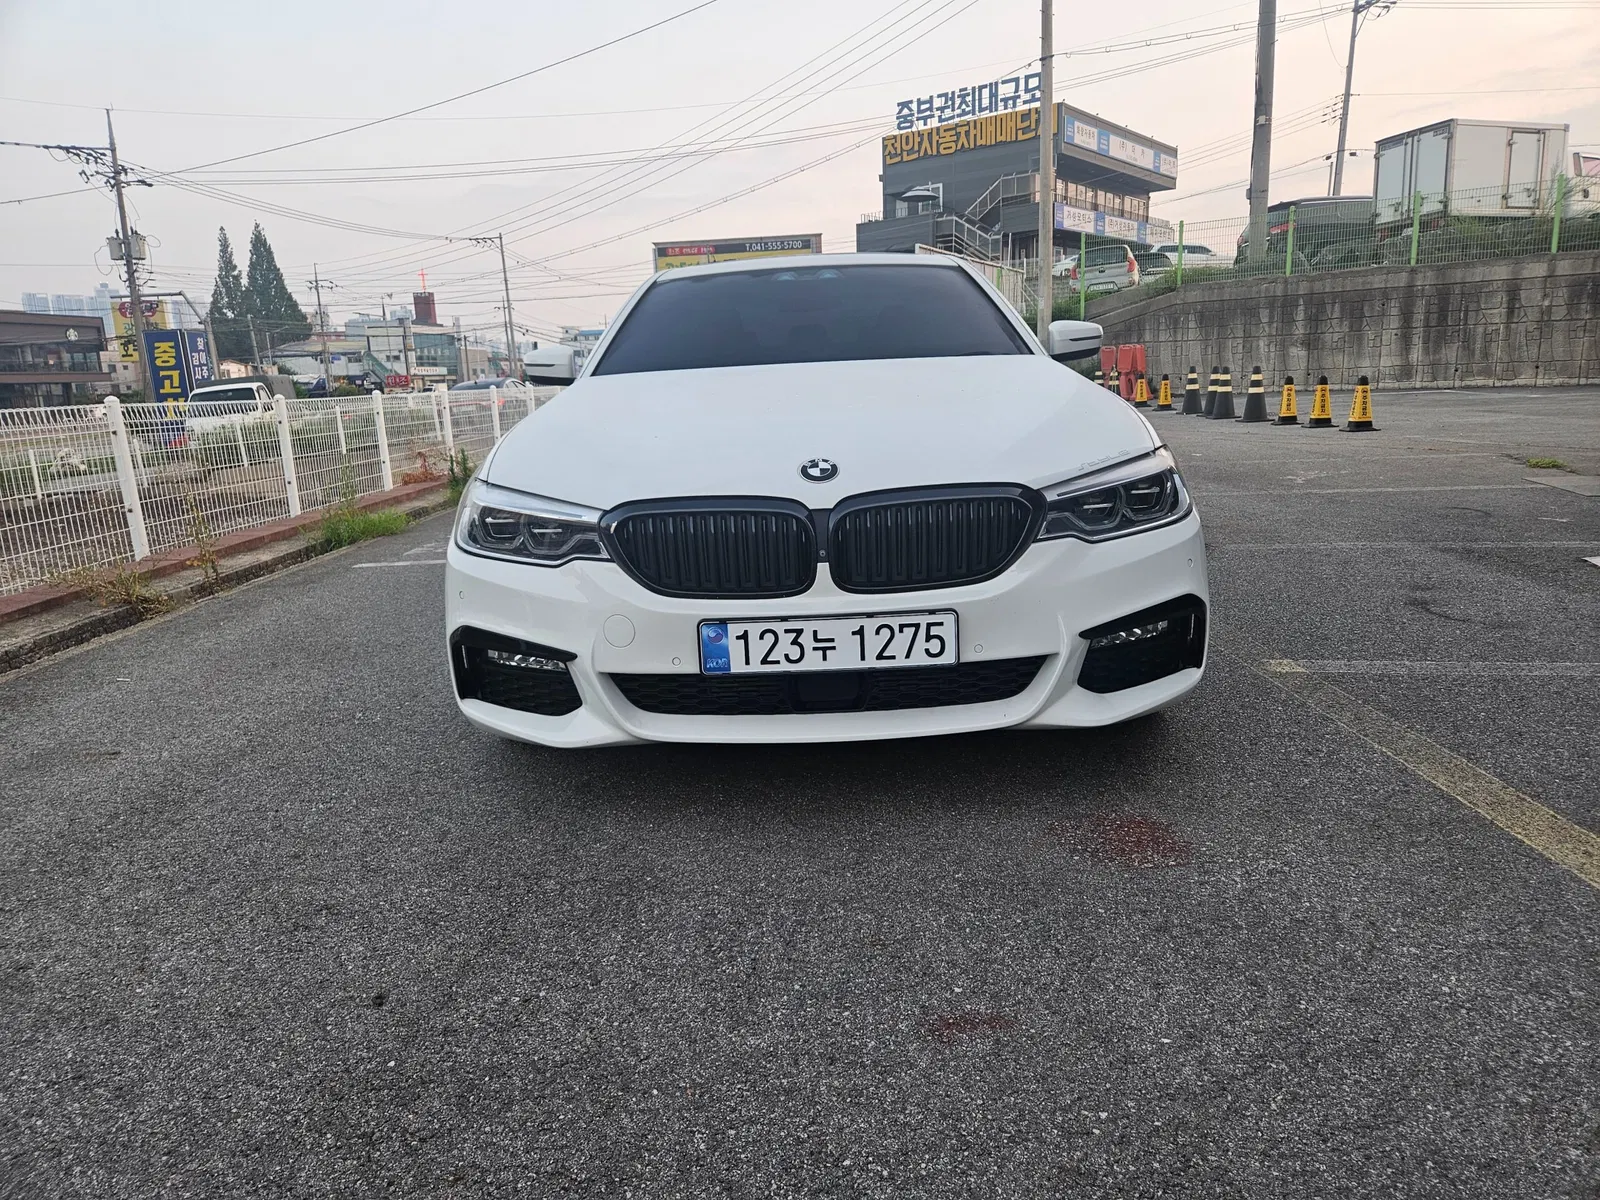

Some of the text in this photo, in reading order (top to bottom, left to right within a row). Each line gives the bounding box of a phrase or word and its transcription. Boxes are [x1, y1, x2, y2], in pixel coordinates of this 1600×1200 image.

[894, 72, 1041, 131] 중부권최대규모
[706, 657, 728, 668] KOR
[735, 621, 946, 666] 123누 1275
